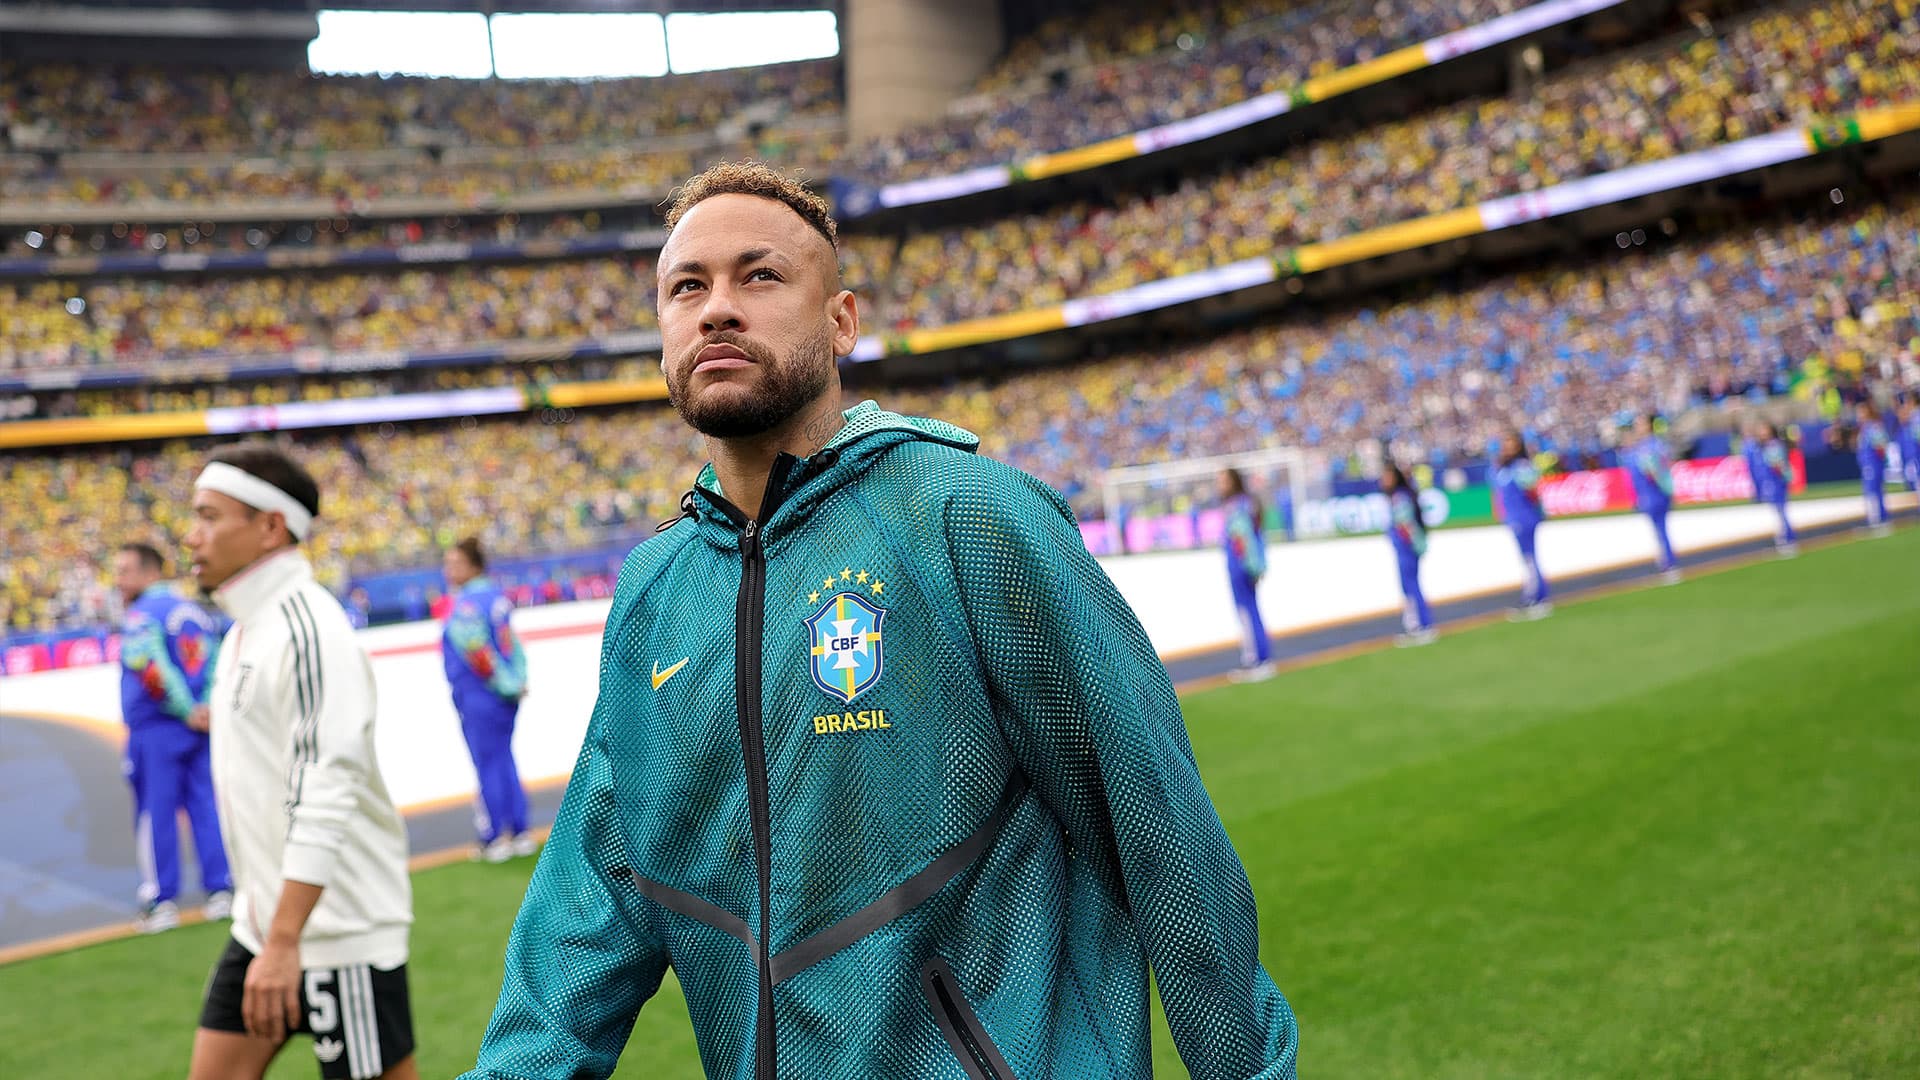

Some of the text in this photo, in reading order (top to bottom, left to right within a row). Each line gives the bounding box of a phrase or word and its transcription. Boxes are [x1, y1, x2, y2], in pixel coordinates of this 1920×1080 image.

[831, 637, 859, 651] CBF
[813, 710, 891, 735] BRASIL
[305, 968, 339, 1033] 5
